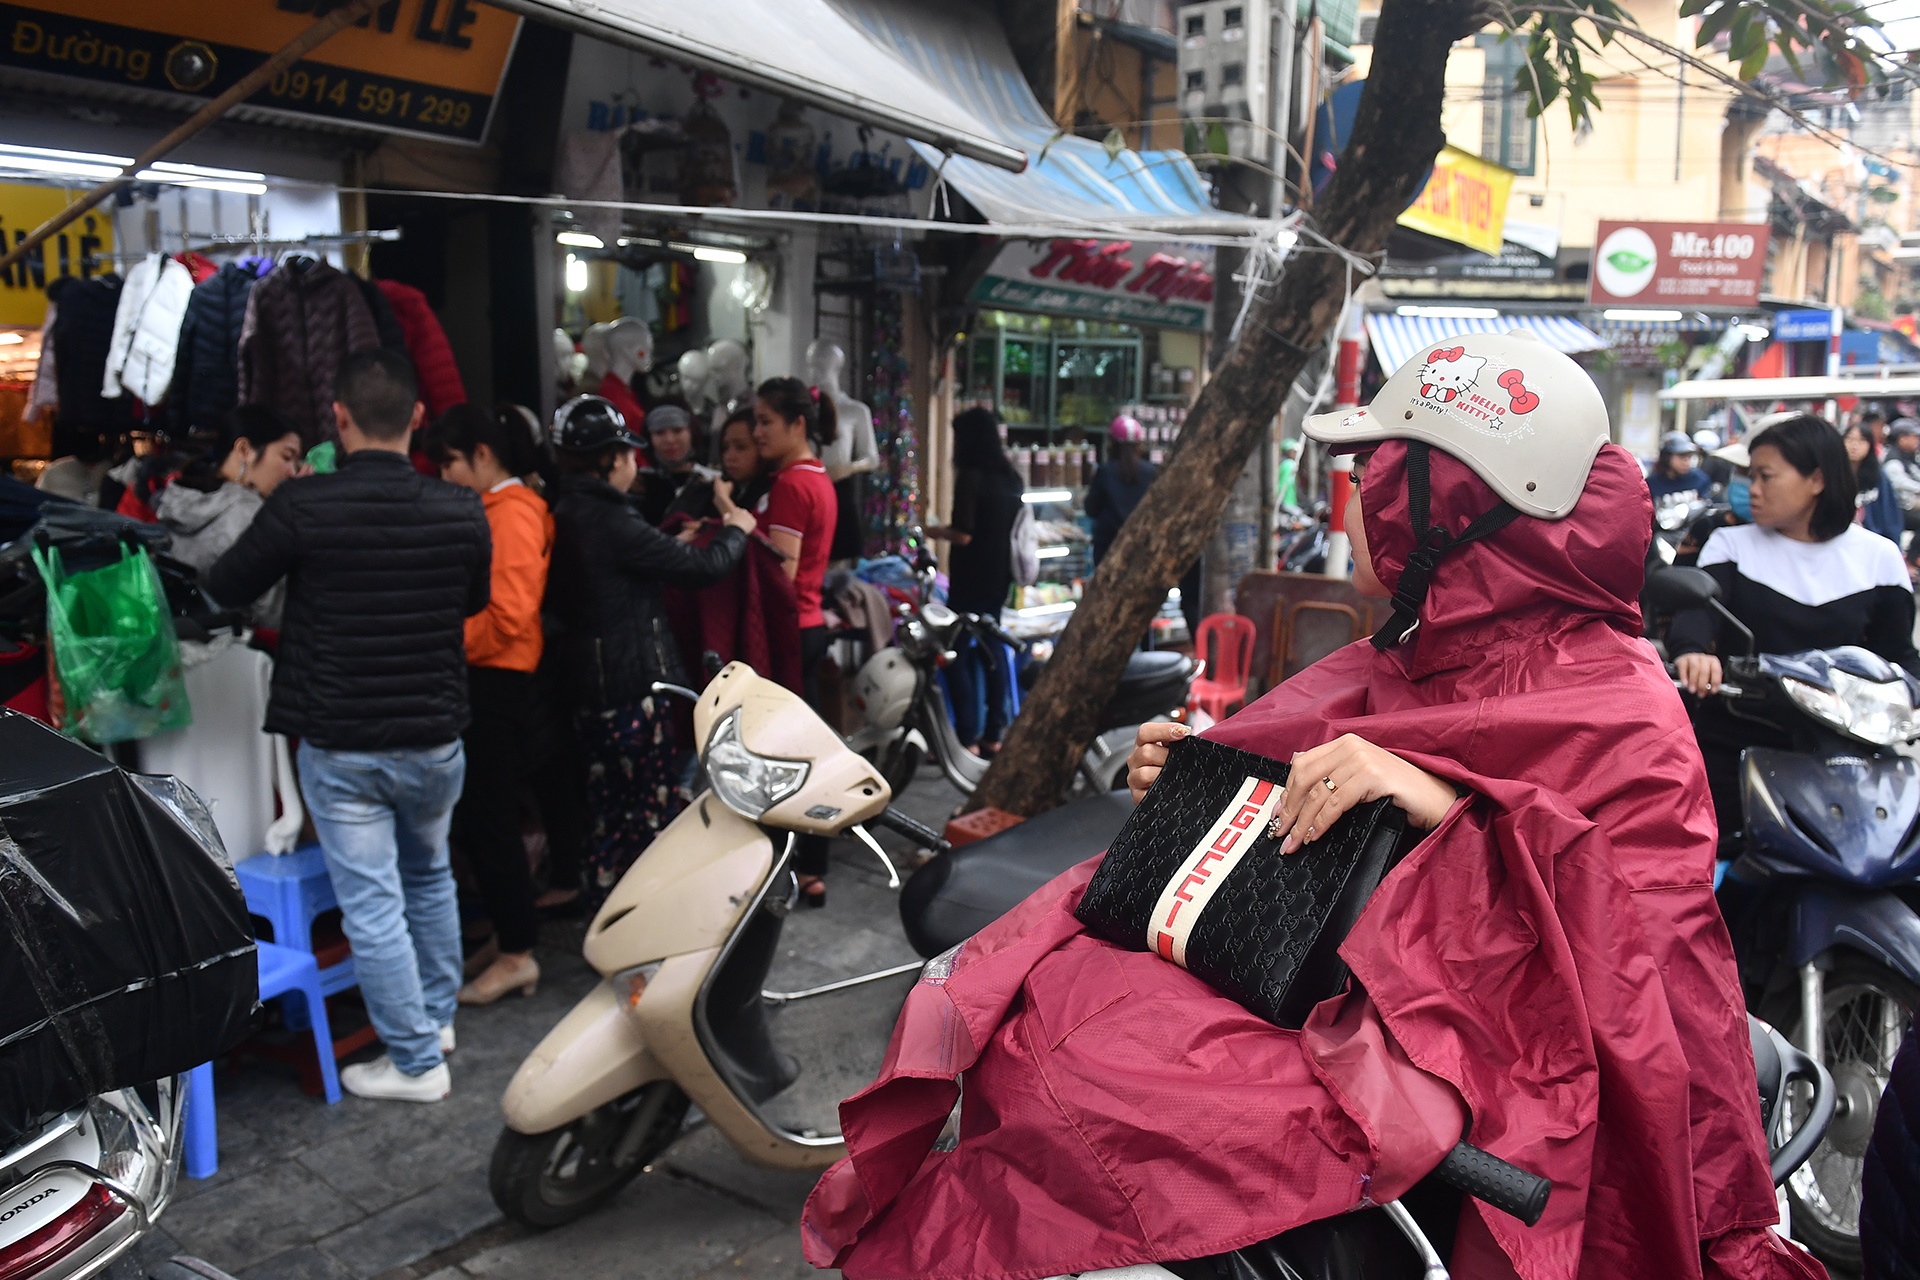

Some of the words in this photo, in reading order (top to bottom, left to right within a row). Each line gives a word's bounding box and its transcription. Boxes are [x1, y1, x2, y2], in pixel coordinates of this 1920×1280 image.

[12, 20, 151, 81] Đường
[269, 70, 348, 106] 0914
[357, 83, 412, 118] 591
[417, 95, 472, 128] 299
[1669, 231, 1755, 260] Mr.100
[1455, 400, 1490, 421] KITTY
[1469, 393, 1506, 416] HELLO
[1825, 755, 1869, 767] HONDA
[1165, 804, 1260, 928] GUCCI
[0, 1187, 60, 1224] ONDA
